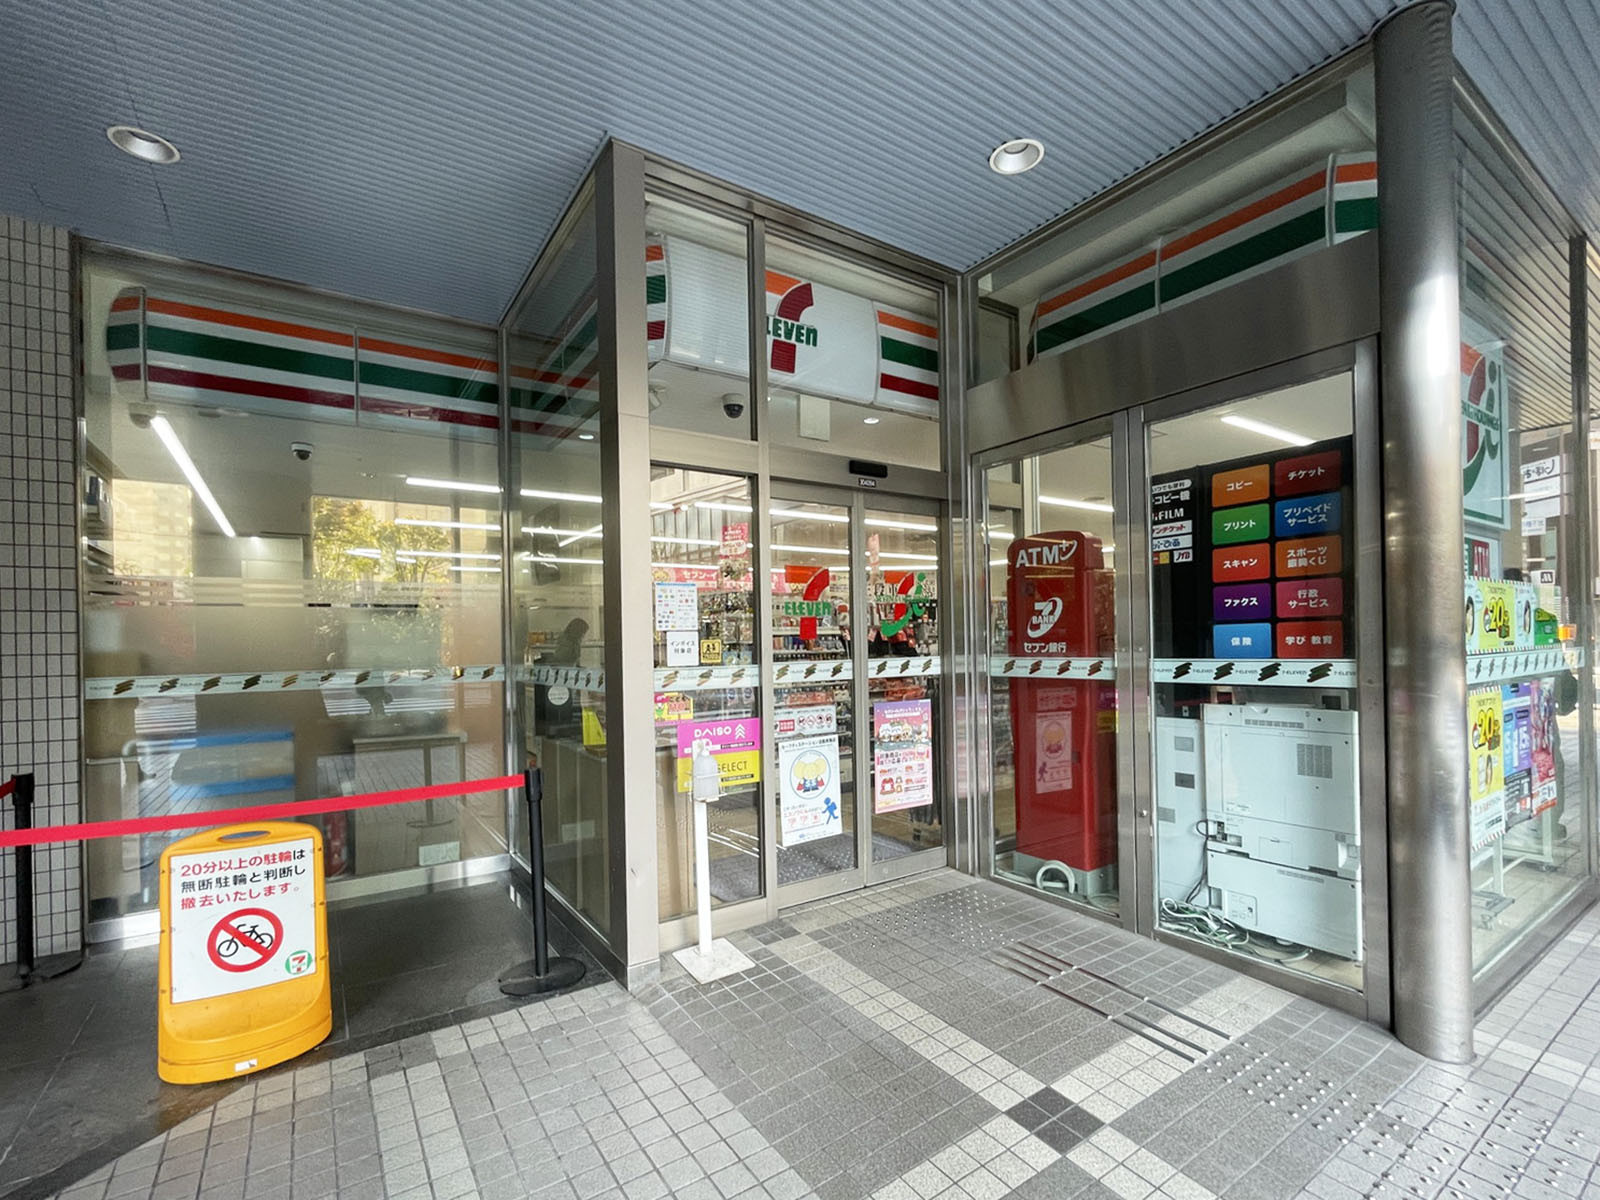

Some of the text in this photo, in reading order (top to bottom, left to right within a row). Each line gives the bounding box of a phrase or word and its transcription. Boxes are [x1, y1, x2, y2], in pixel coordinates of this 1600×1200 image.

[1288, 467, 1325, 481] チケット
[1226, 480, 1253, 492] コピー
[1283, 503, 1332, 518] プリペイド
[1224, 519, 1256, 531] プリント
[1287, 514, 1328, 527] サービス
[1286, 546, 1327, 558] スポーツ
[1223, 558, 1258, 569] スキャン
[1224, 597, 1258, 608] ファクス
[1287, 598, 1329, 609] サービス
[1024, 642, 1067, 653] セブン銀行
[694, 726, 732, 738] DAISO
[181, 849, 306, 878] 20分以上の駐輪は
[181, 865, 306, 893] 無断駐輪と判断し
[181, 882, 300, 911] 撤去いたします。
